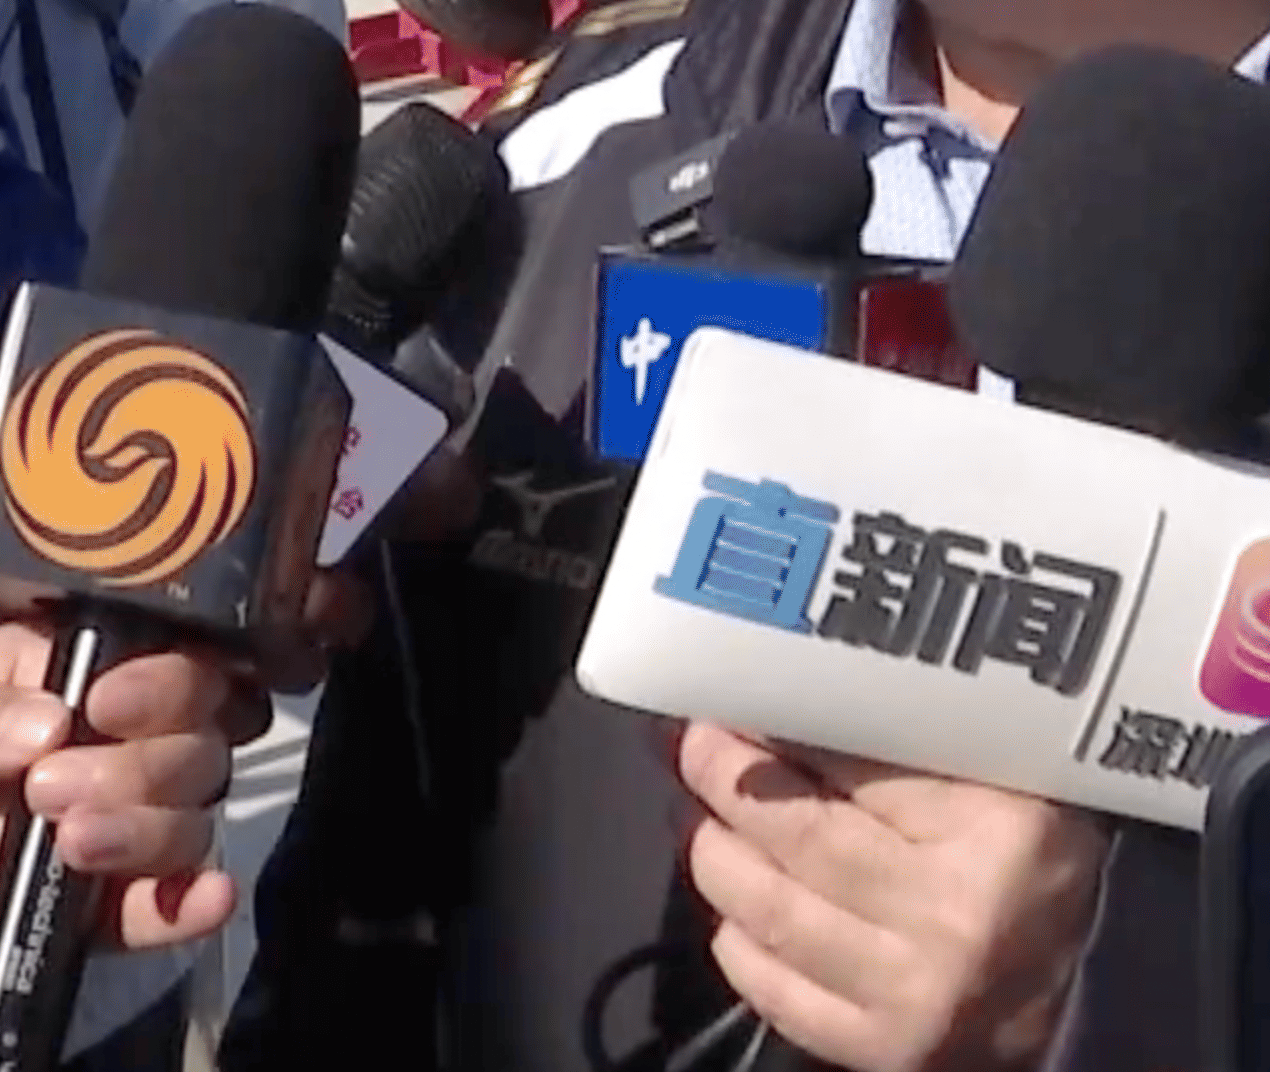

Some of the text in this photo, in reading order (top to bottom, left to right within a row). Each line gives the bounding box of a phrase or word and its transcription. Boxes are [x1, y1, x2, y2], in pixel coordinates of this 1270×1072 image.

[620, 317, 672, 405] 中
[654, 471, 1121, 697] 直新闻
